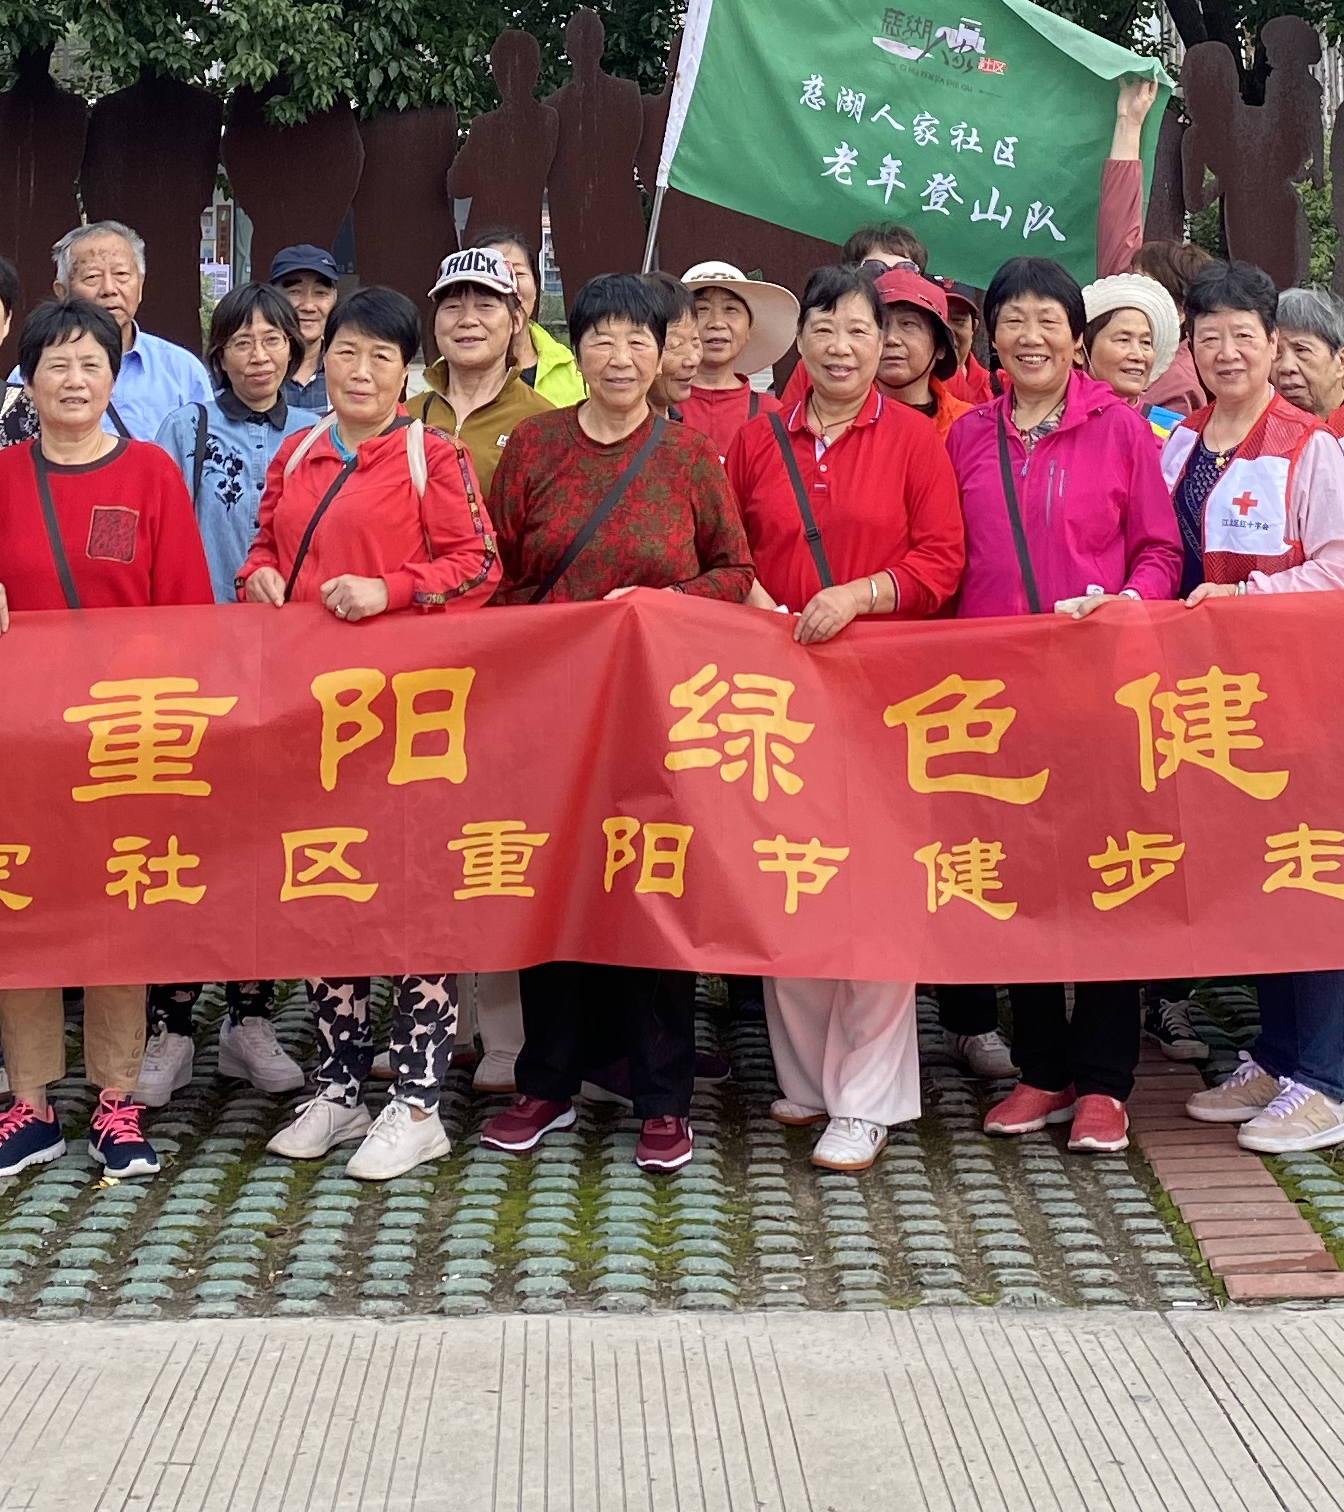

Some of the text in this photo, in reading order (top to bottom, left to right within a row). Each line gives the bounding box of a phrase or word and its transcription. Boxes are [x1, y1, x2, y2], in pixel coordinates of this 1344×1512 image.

[800, 74, 1019, 169] 慈湖人家社区
[821, 141, 1066, 242] 老年登山队
[445, 251, 498, 277] ROCK
